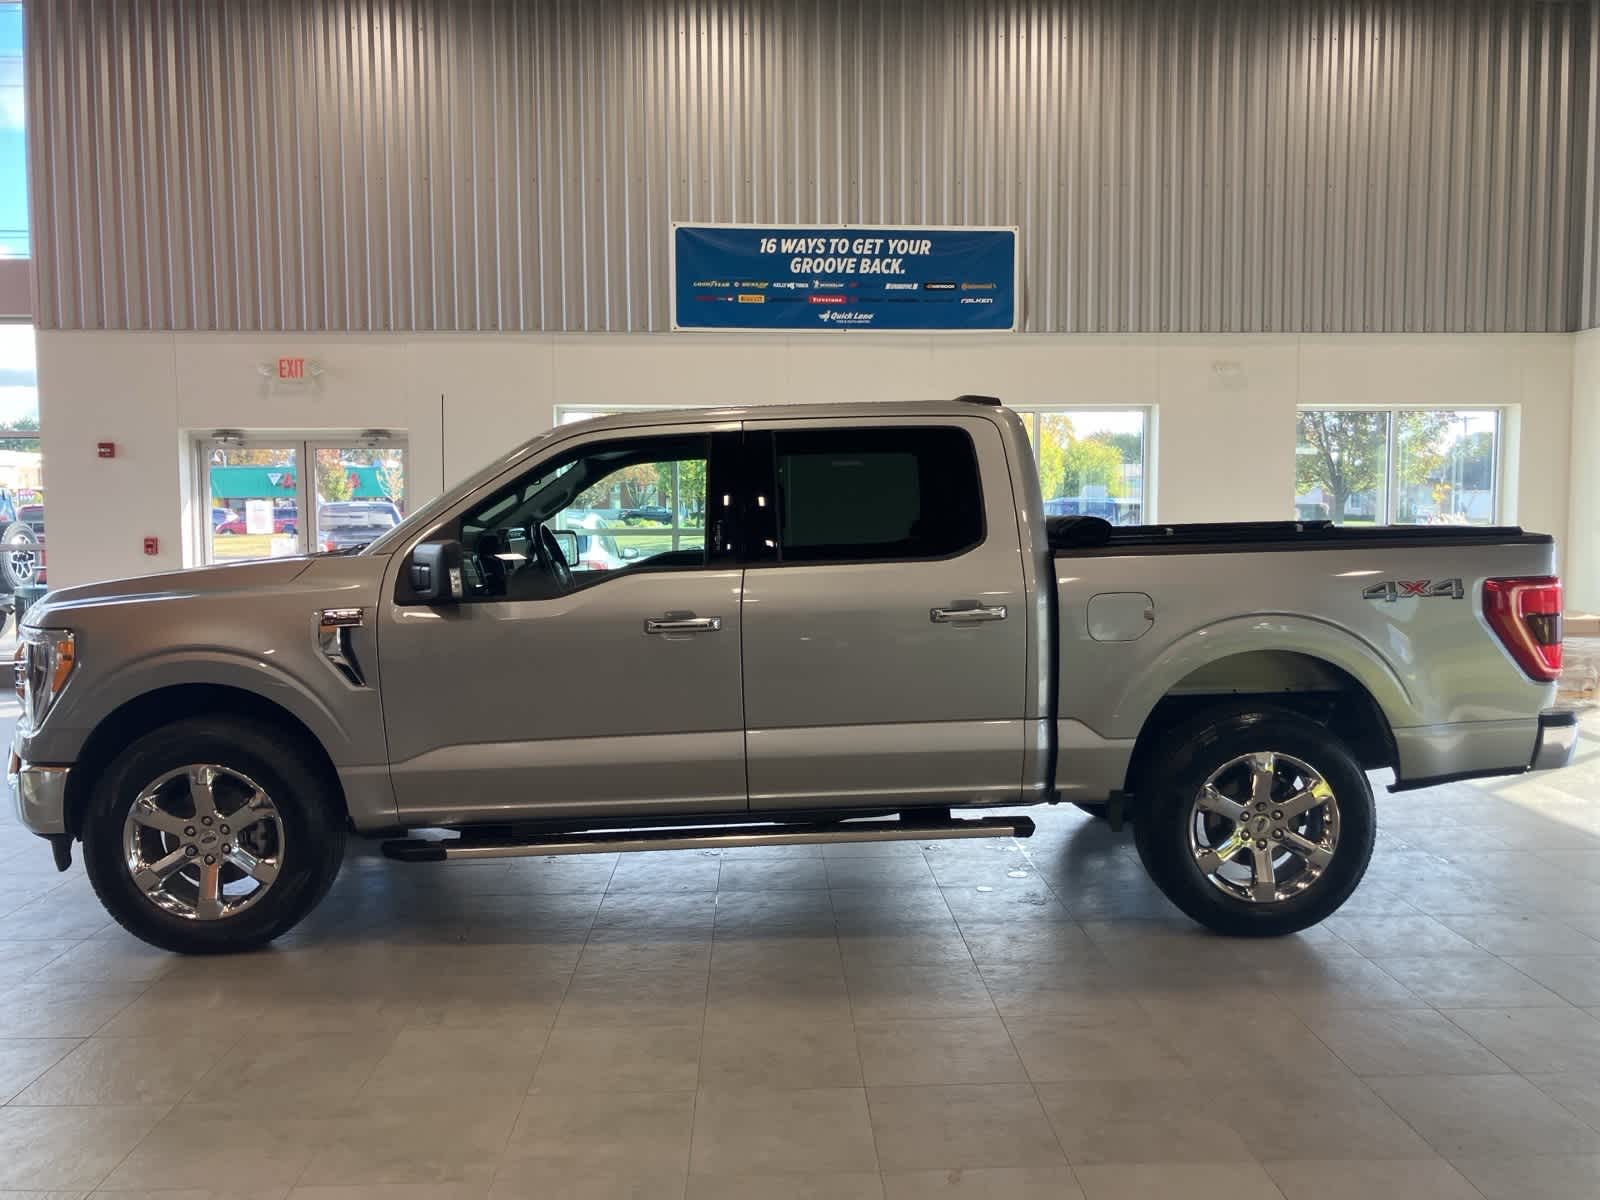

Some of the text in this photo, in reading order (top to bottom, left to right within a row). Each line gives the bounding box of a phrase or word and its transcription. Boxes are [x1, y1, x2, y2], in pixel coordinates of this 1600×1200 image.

[760, 238, 932, 255] 16 WAYS TO GET YOUR
[790, 257, 906, 274] GROOVE BACK.
[693, 280, 730, 288] GOODYEAR
[830, 312, 875, 320] Quick Lane
[278, 357, 305, 379] EXIT
